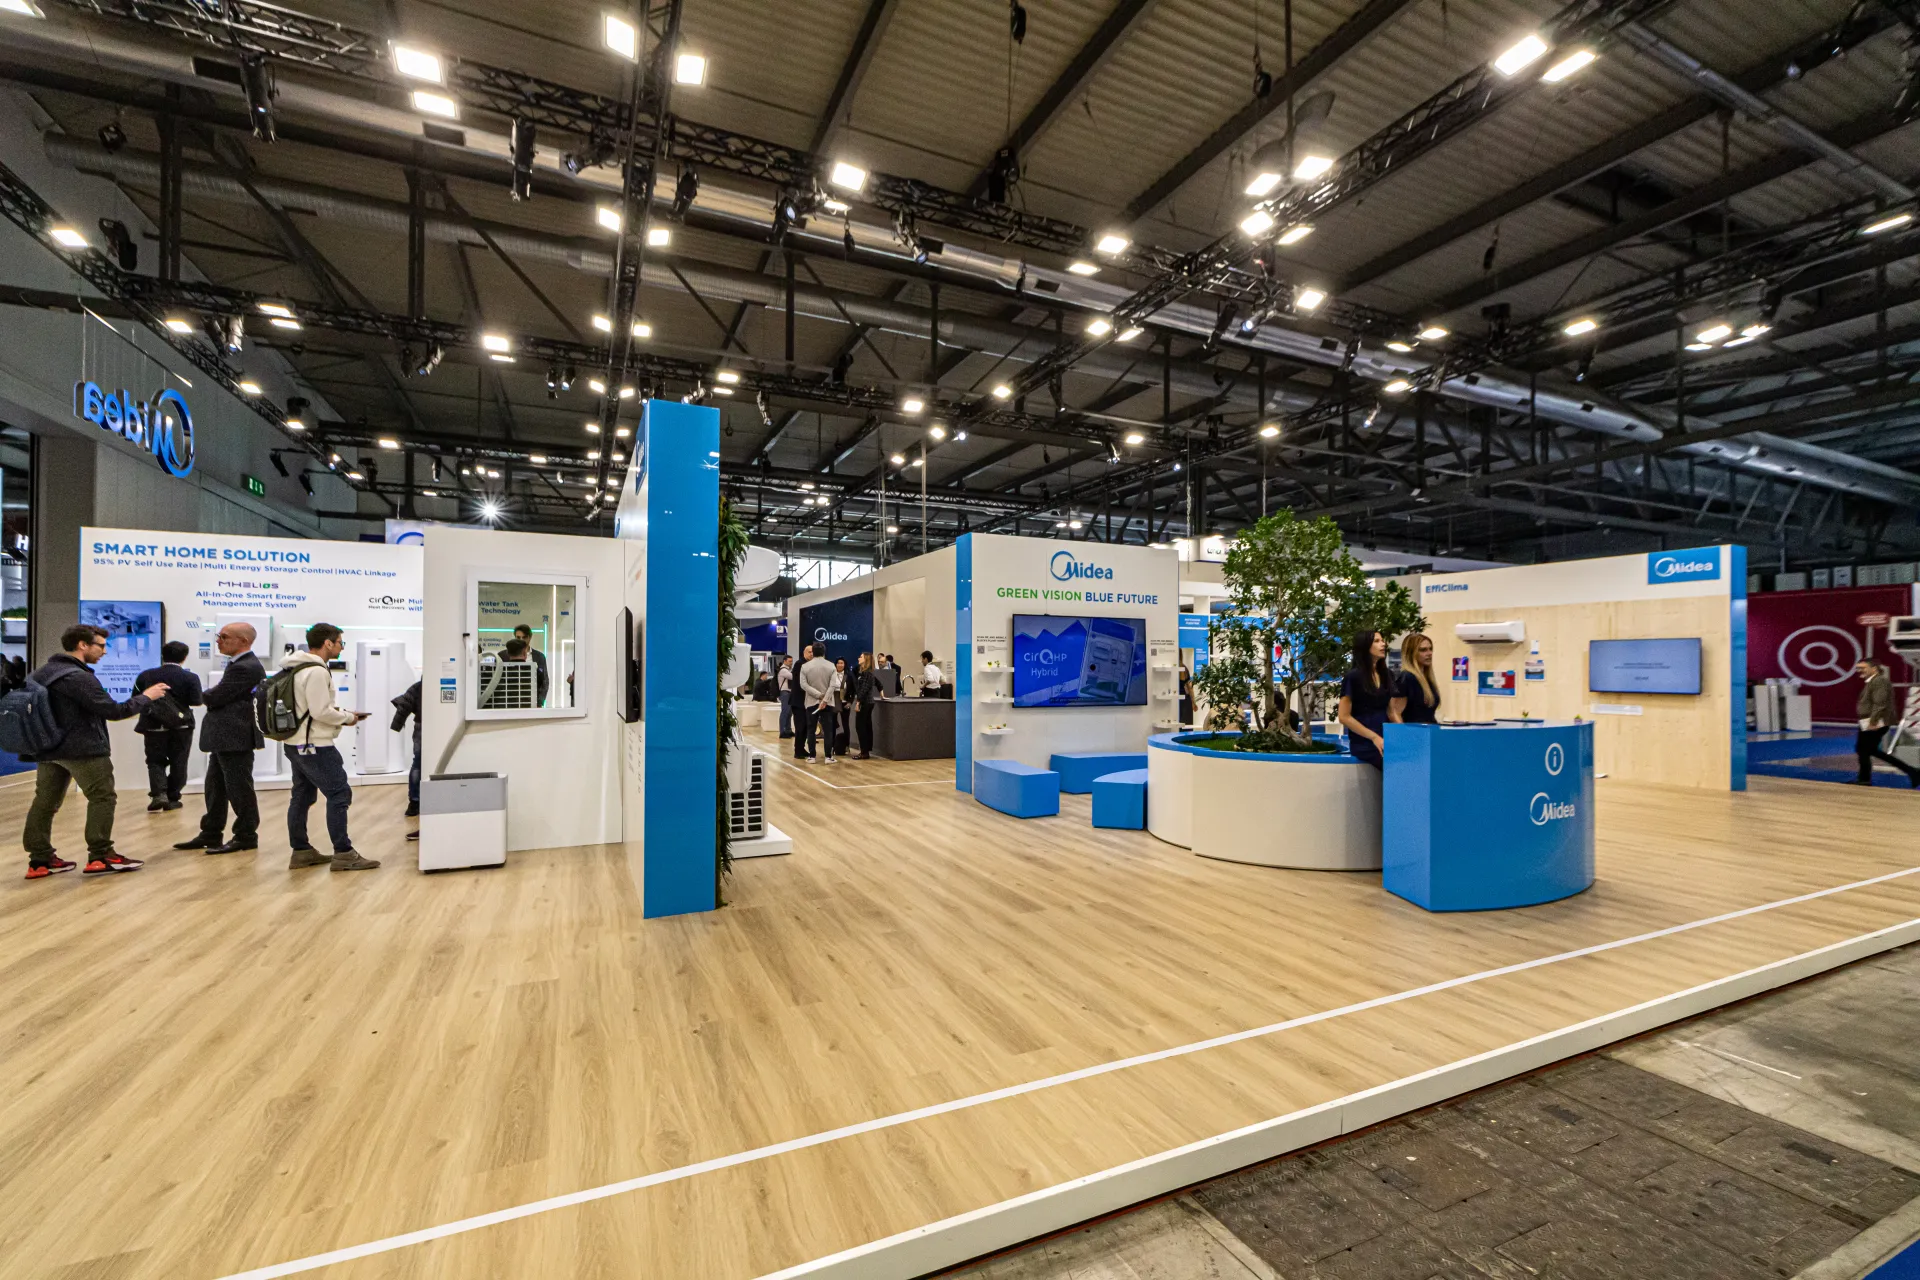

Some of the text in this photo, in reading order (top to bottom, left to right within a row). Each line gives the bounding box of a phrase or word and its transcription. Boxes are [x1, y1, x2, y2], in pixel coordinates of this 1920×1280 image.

[93, 542, 311, 563] SMART HOME SOLUTION
[230, 564, 261, 572] Energy
[264, 565, 299, 574] Storage
[338, 568, 362, 576] HVAC
[1050, 550, 1113, 582] Midea
[1654, 556, 1714, 577] Midea
[1425, 584, 1469, 594] EffiClima
[196, 591, 307, 602] All-In-One Smart Energy
[996, 587, 1158, 605] GREEN VISION BLUE FUTURE
[203, 599, 297, 609] Management System
[481, 607, 521, 615] Technology
[814, 627, 848, 642] Midea
[1031, 667, 1059, 678] Hybrid
[1529, 791, 1575, 826] Midea
